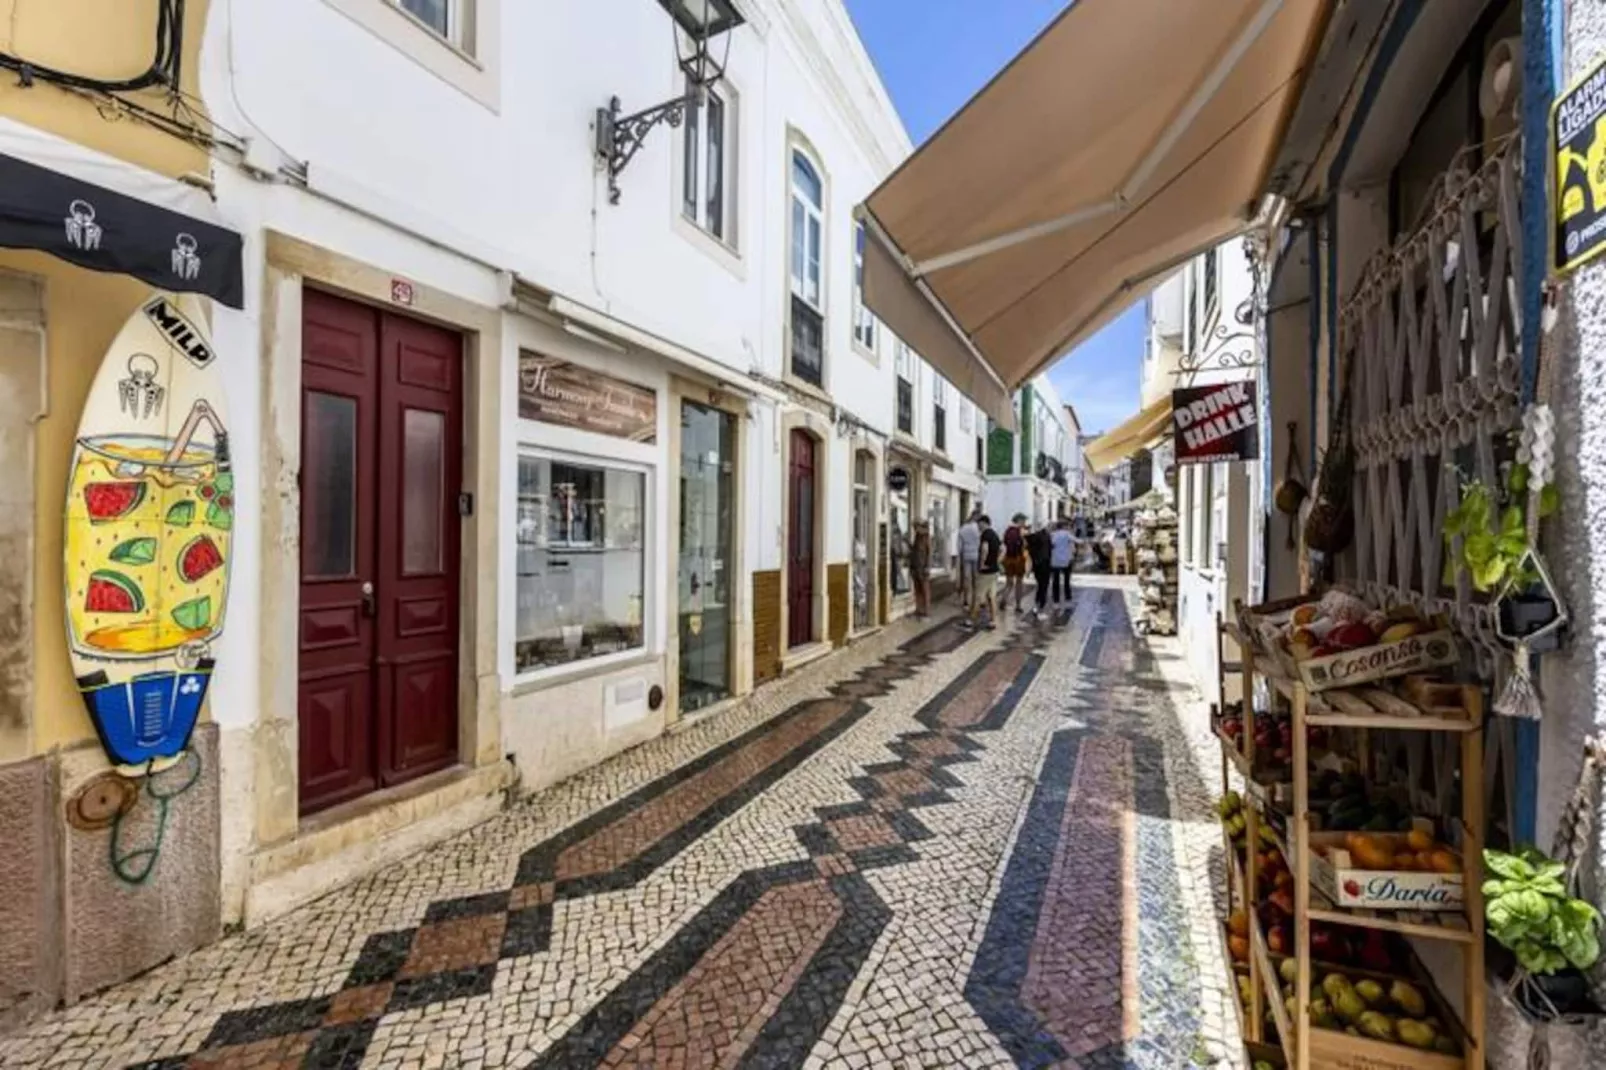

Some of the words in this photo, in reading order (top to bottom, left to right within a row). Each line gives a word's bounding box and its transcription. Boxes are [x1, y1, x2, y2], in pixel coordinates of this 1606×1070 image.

[148, 302, 209, 361] MILP
[521, 364, 591, 411] Harmony
[1173, 382, 1250, 430] DRINK
[1183, 403, 1257, 450] HALLE
[1367, 877, 1449, 902] Daria
